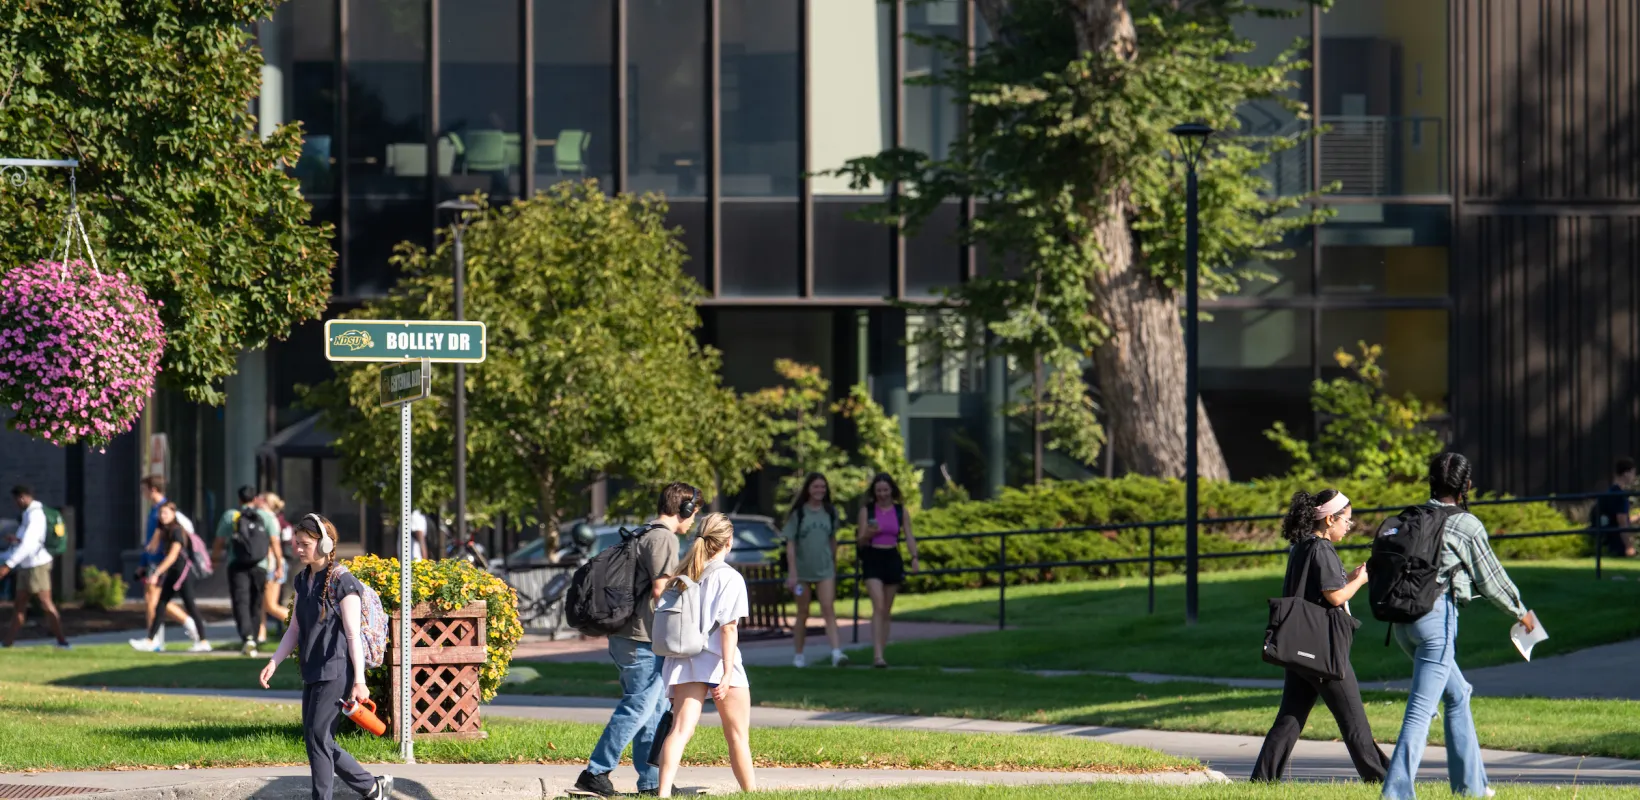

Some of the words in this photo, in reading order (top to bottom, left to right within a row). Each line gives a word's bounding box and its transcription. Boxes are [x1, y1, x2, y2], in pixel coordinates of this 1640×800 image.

[334, 335, 361, 346] NDSU
[386, 332, 444, 350] BOLLEY
[448, 333, 470, 351] DR
